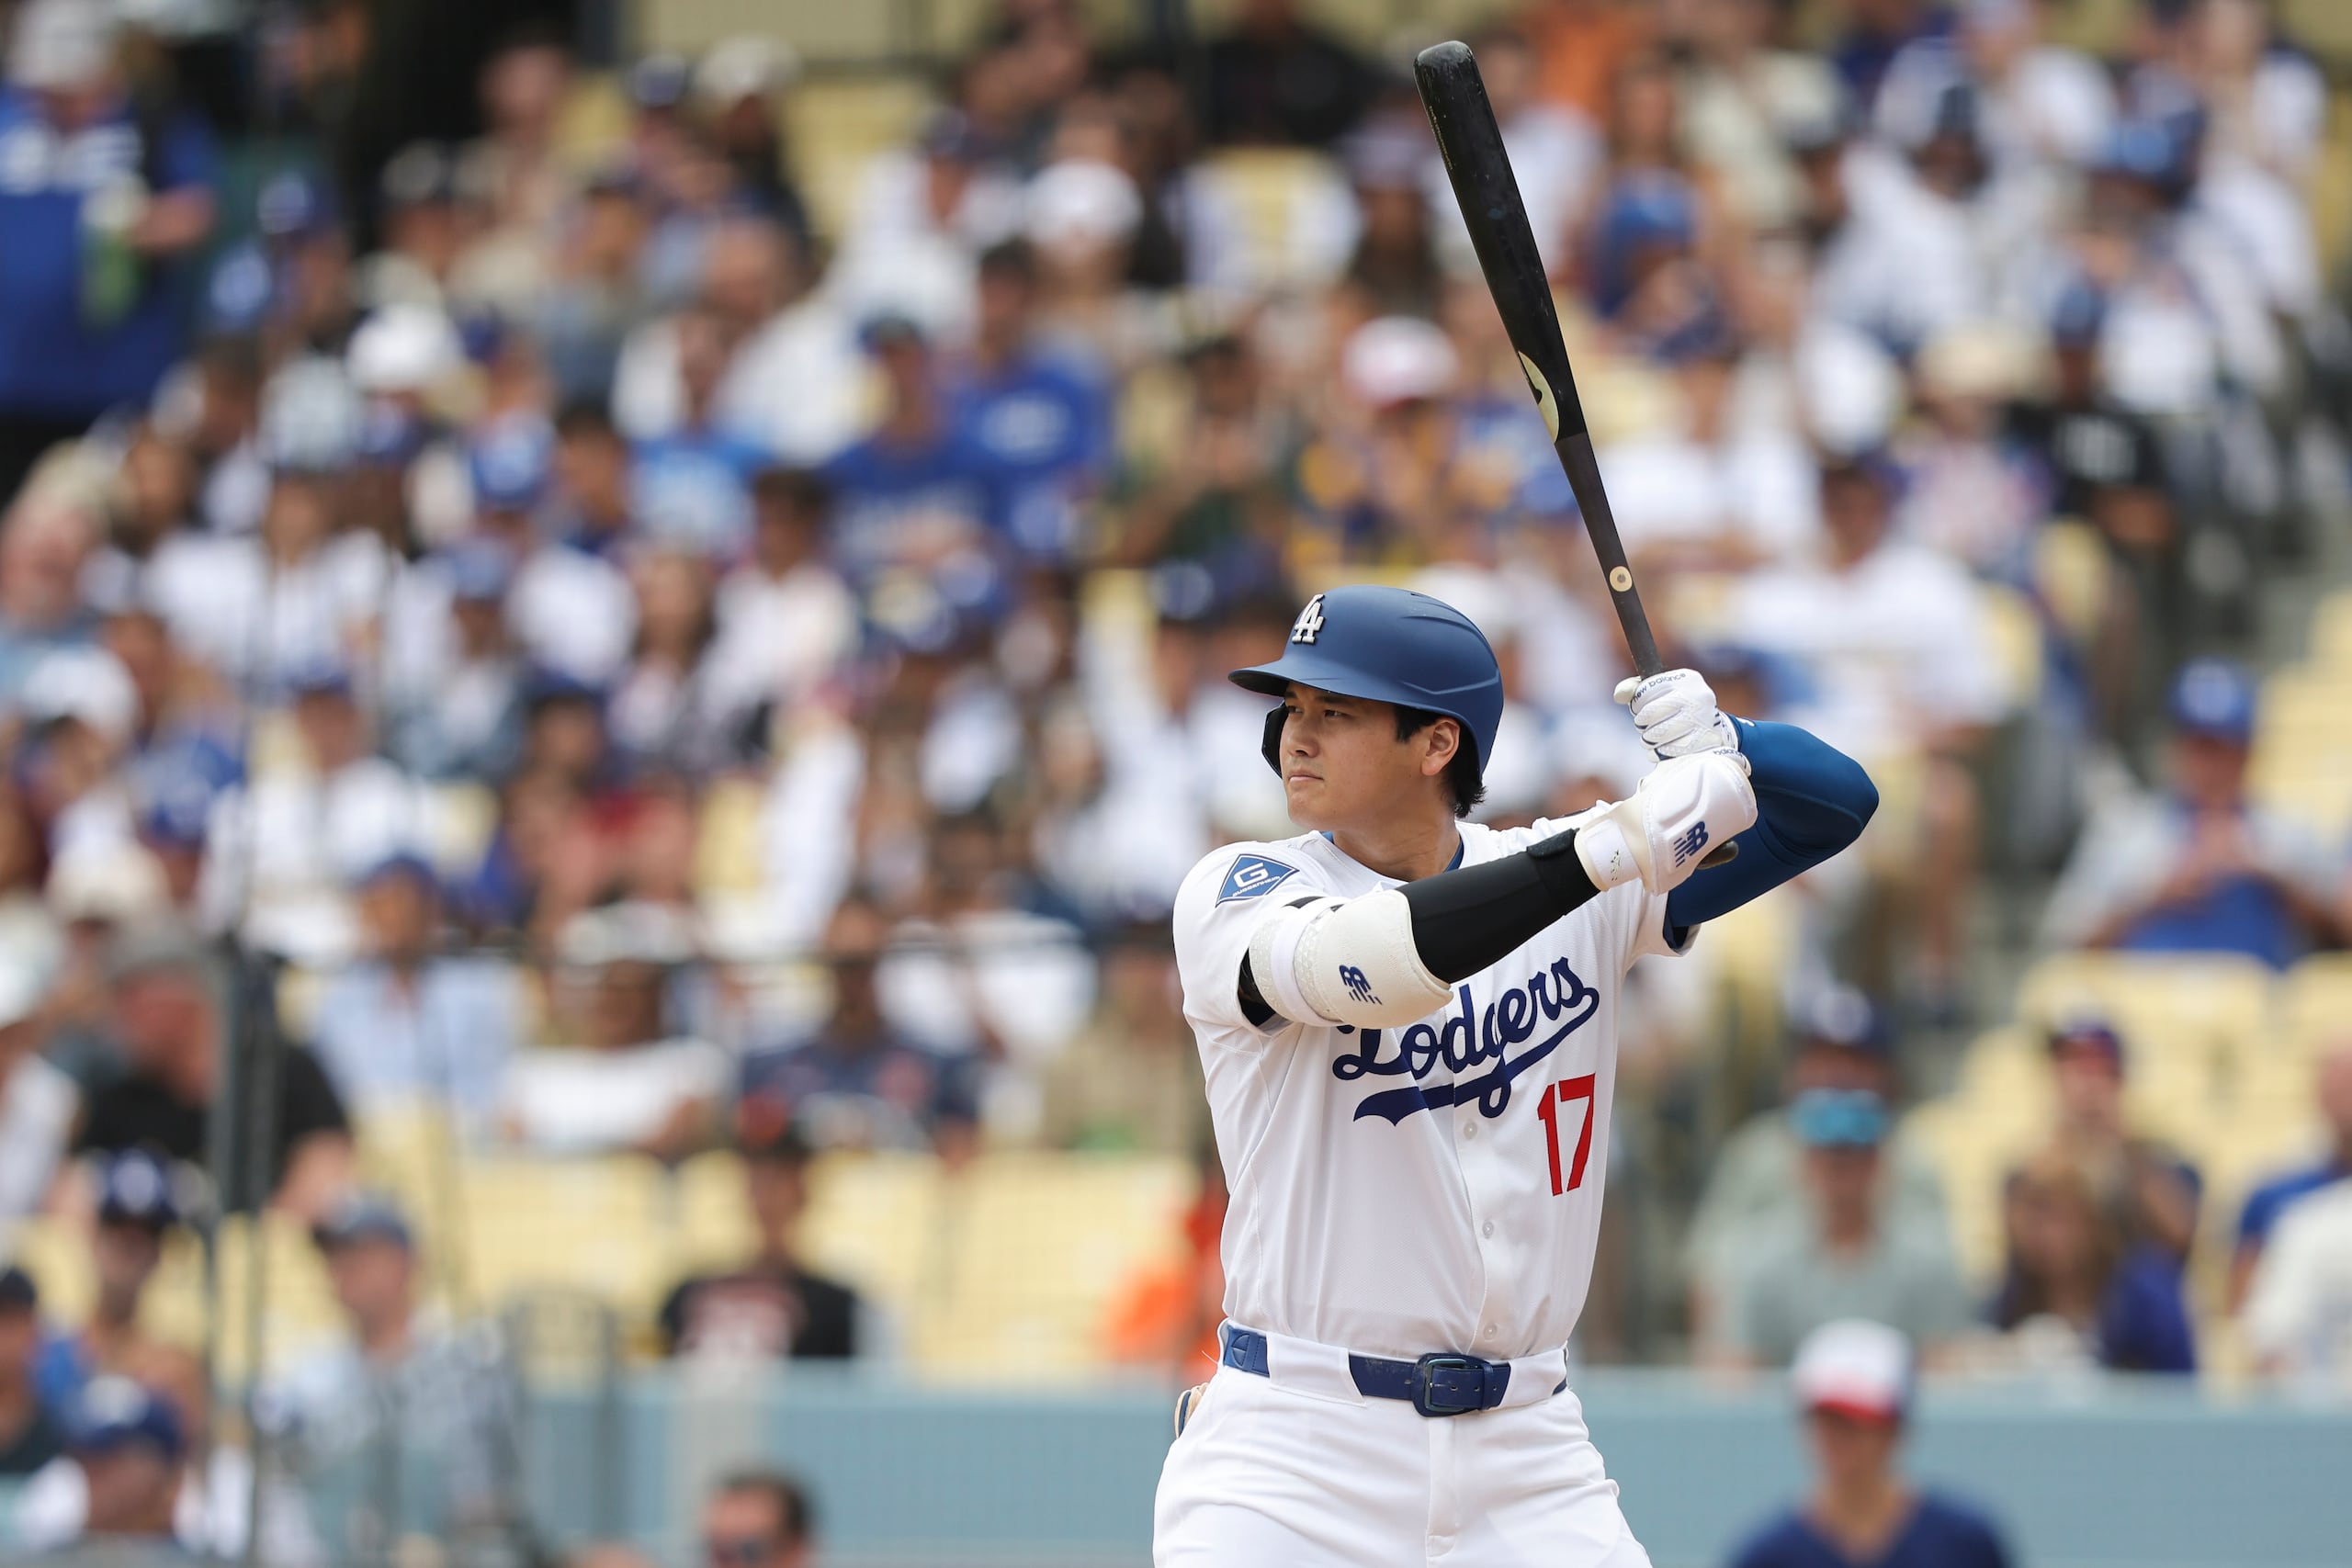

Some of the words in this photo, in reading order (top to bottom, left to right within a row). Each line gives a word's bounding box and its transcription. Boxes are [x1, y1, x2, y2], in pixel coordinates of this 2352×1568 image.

[1292, 593, 1325, 644] LA
[1632, 685, 1647, 703] new
[1648, 672, 1687, 688] balance
[1537, 1073, 1596, 1197] 17
